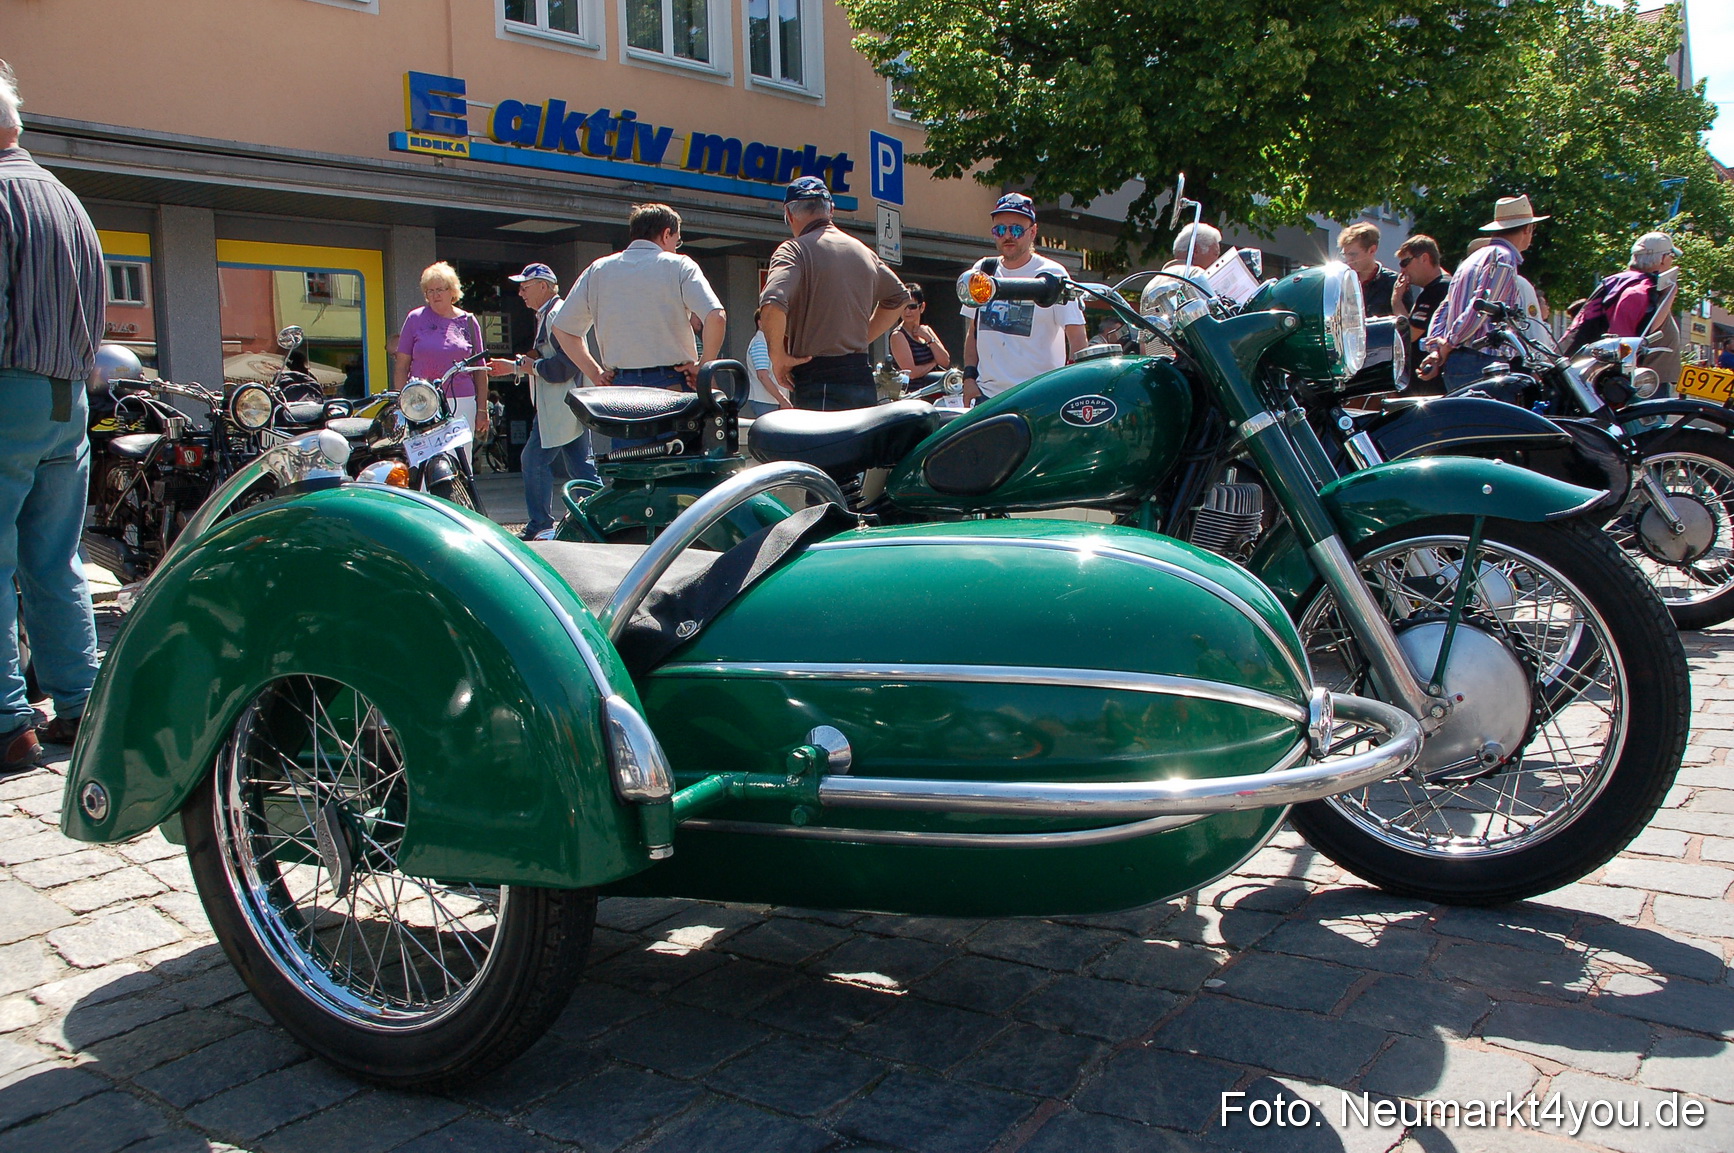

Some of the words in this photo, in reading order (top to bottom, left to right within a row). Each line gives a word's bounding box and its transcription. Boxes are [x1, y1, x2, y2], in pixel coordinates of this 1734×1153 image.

[404, 71, 467, 137] E
[487, 98, 674, 164] aktiv
[680, 131, 855, 193] markt
[410, 136, 467, 154] EDEKA
[877, 133, 896, 192] P
